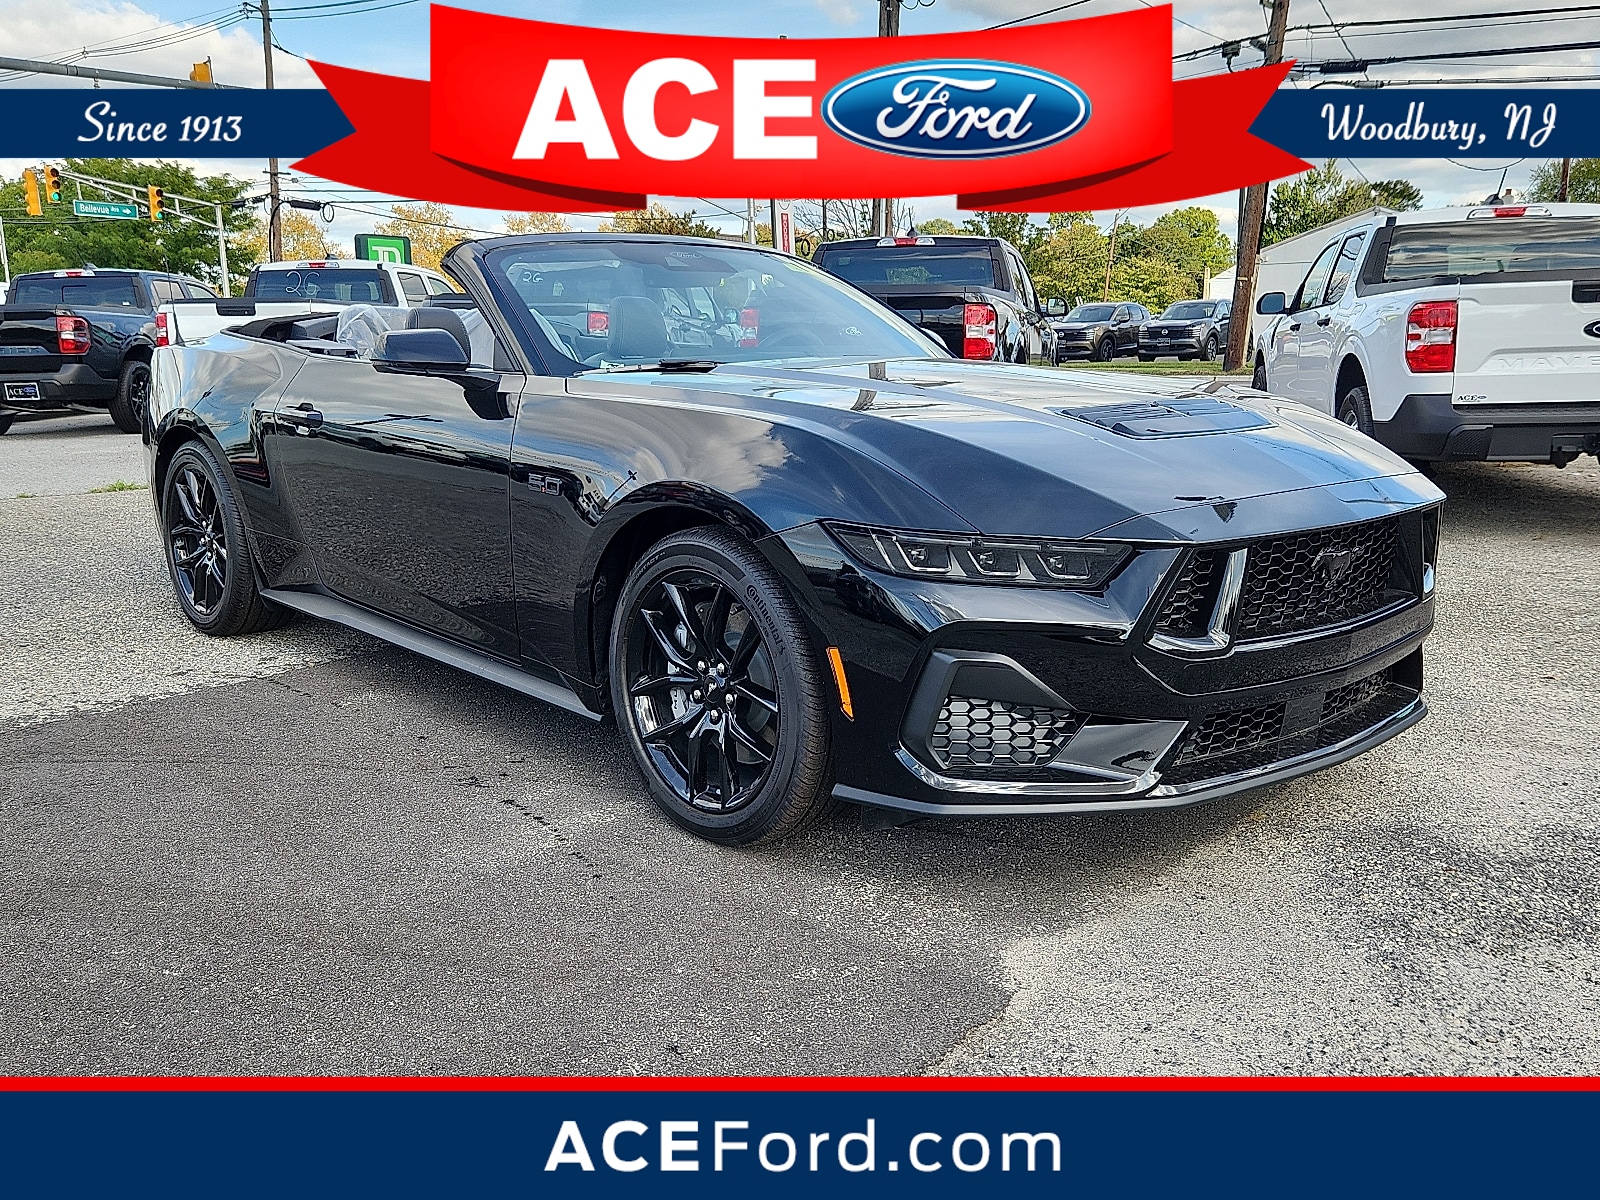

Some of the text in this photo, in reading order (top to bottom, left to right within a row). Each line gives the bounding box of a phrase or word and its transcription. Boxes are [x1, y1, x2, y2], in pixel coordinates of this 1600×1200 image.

[80, 203, 109, 214] Bellevue
[371, 245, 401, 263] TD
[528, 473, 561, 496] 5.0
[746, 584, 783, 645] Continental
